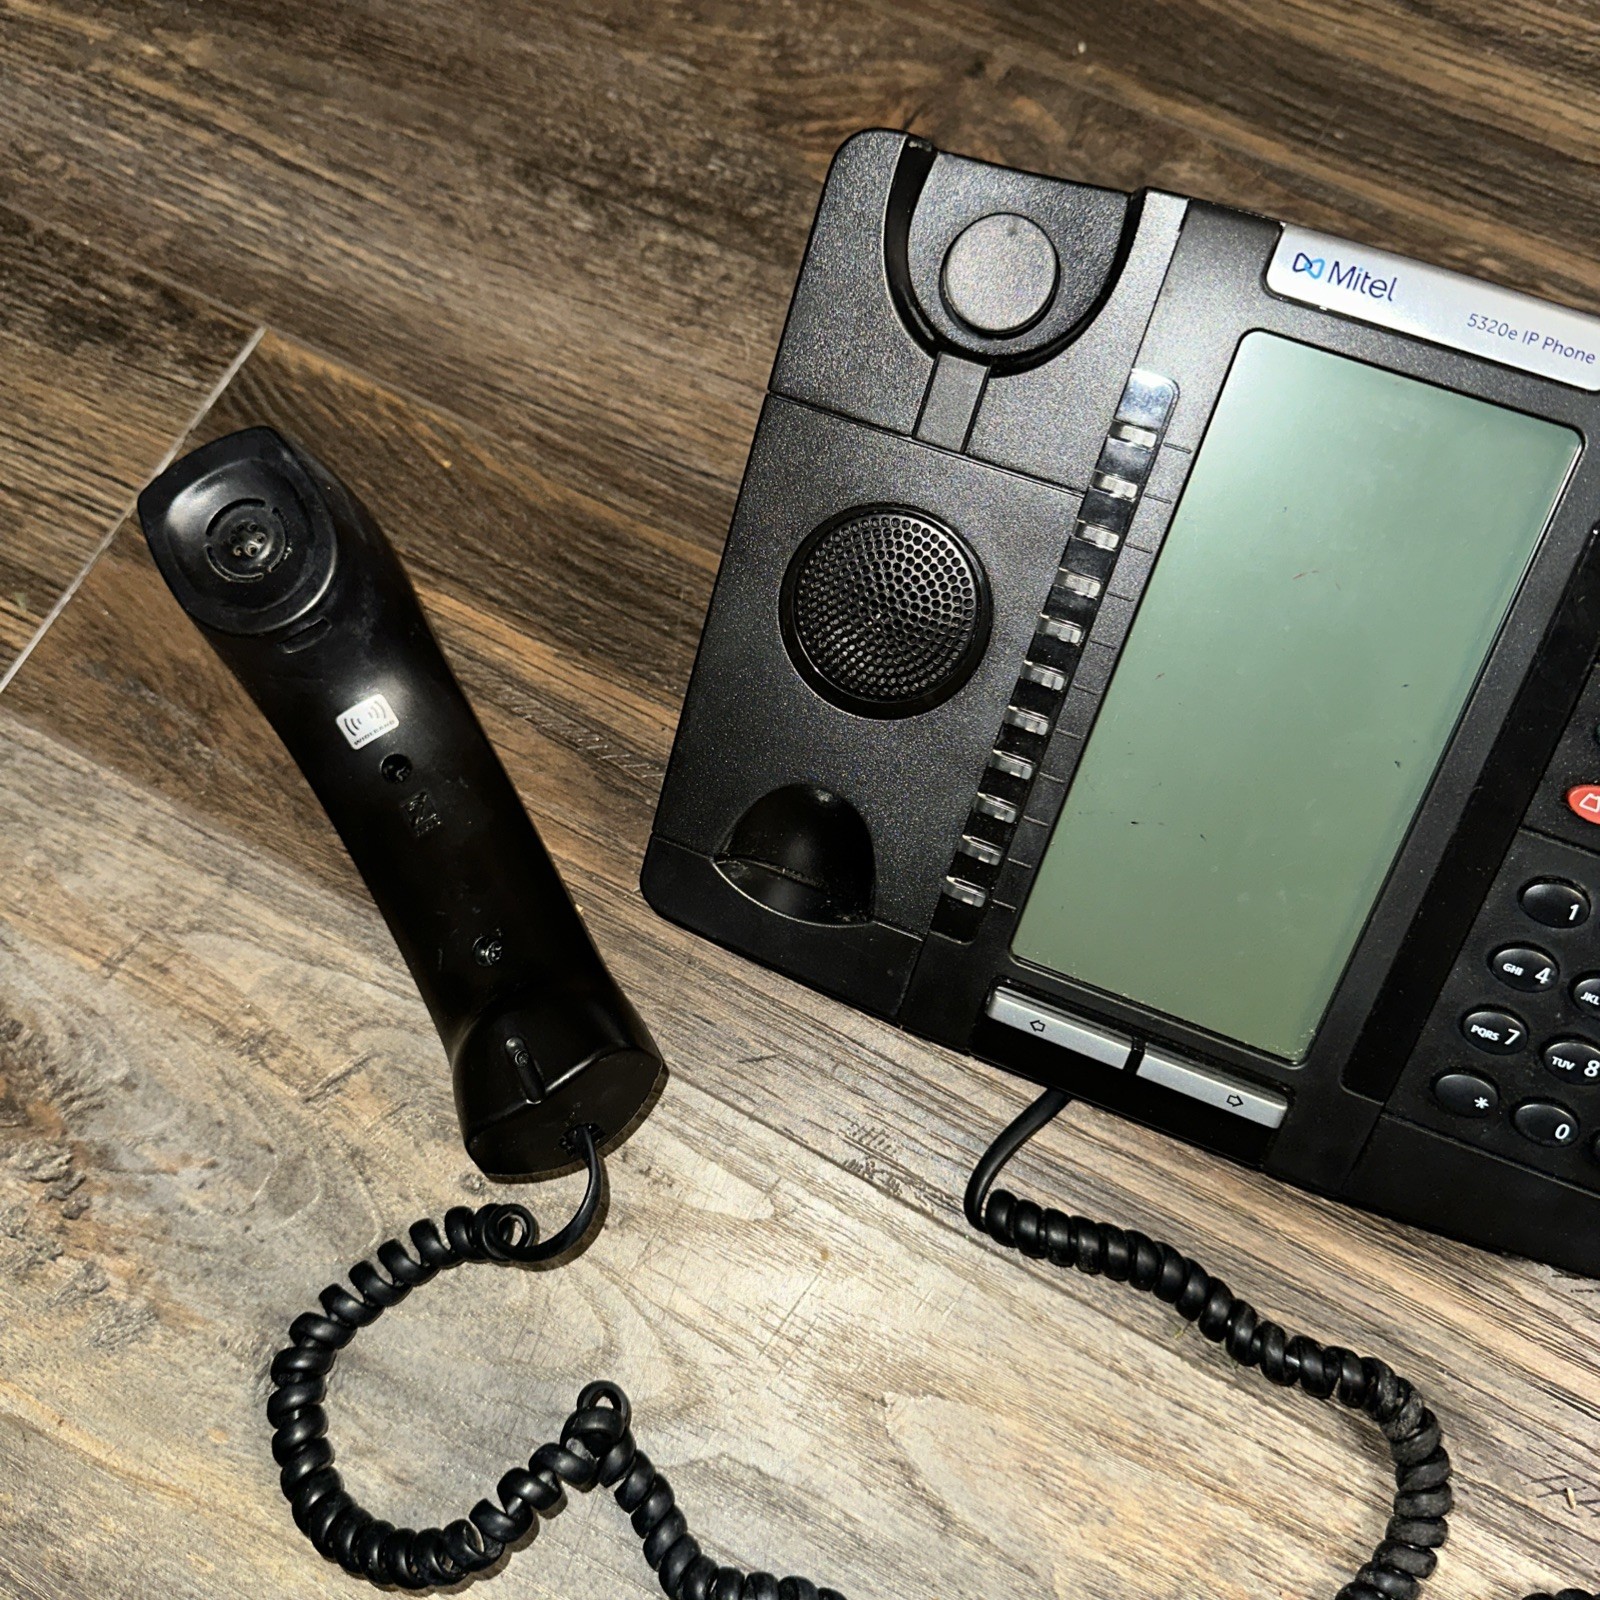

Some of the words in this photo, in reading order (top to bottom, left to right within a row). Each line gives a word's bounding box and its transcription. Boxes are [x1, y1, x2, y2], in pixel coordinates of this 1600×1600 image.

[1327, 261, 1398, 302] Mitel
[1467, 313, 1518, 341] 5320e
[1522, 331, 1539, 347] IP
[1542, 336, 1596, 365] Phone
[1568, 904, 1580, 921] 1
[1502, 963, 1524, 977] GHI
[1535, 967, 1551, 985] 4
[1580, 991, 1600, 1006] JKL
[1470, 1024, 1500, 1042] PQRS
[1504, 1028, 1521, 1045] 7
[1551, 1056, 1575, 1071] TUV
[1584, 1060, 1600, 1078] 8
[1555, 1124, 1570, 1140] 0
